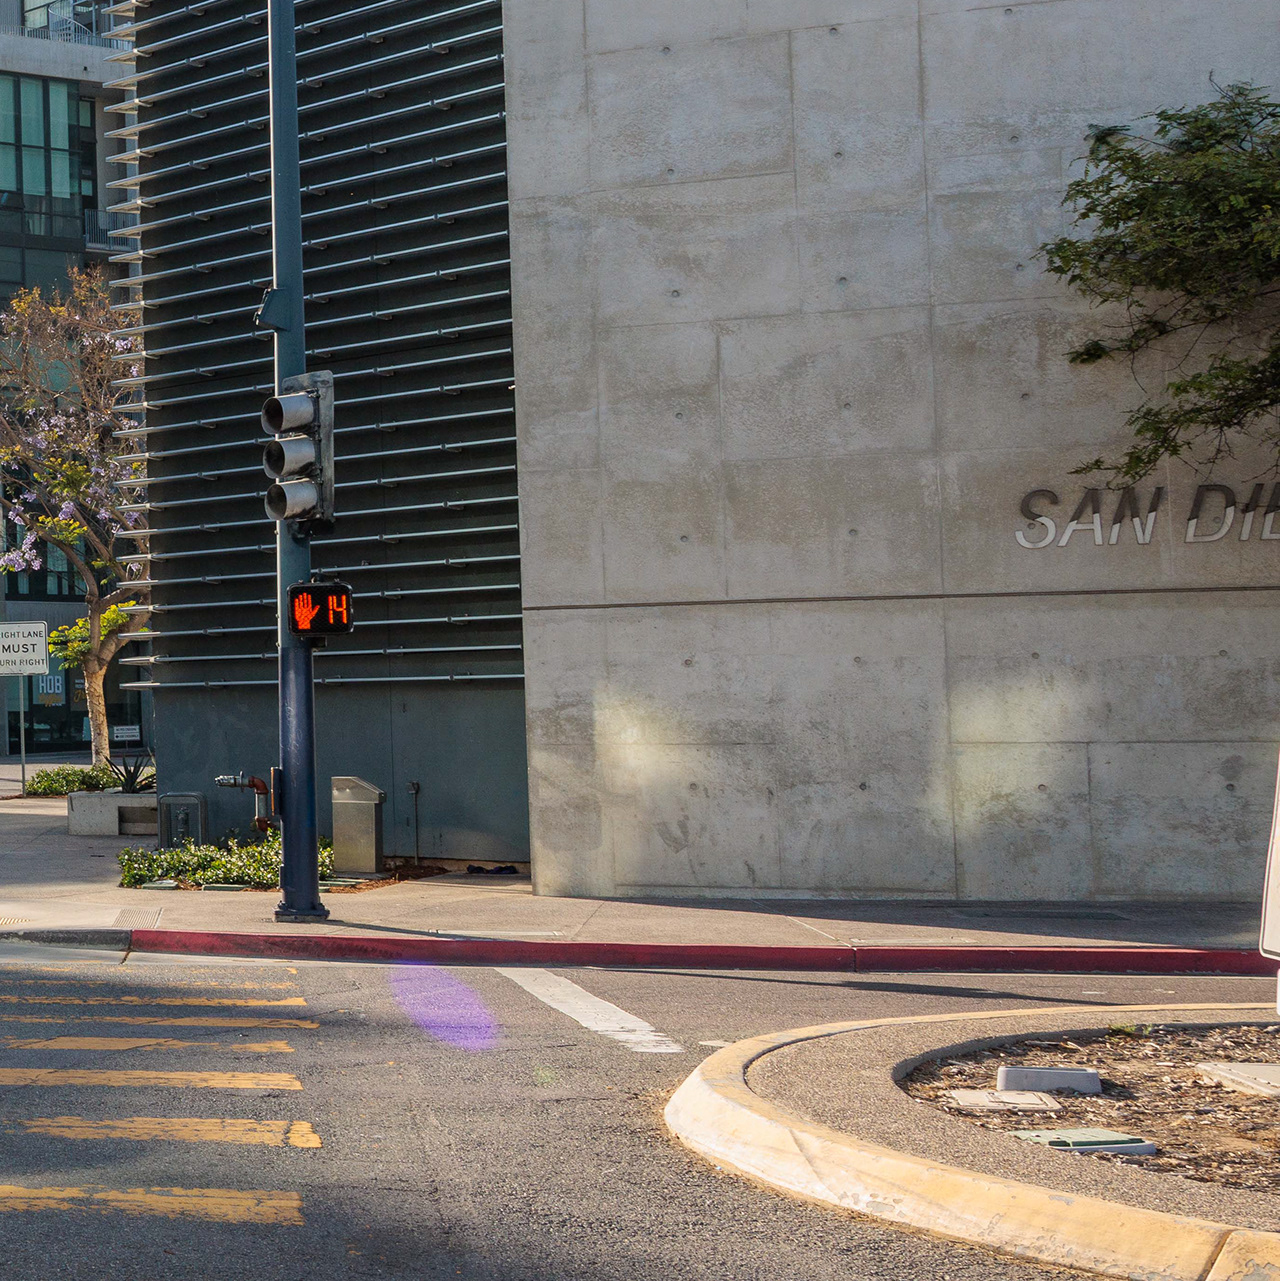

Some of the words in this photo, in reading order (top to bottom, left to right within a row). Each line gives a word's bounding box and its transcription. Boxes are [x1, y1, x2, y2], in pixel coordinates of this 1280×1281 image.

[1014, 486, 1165, 549] SAN
[328, 594, 348, 624] 14
[22, 630, 44, 638] LANE
[2, 643, 38, 654] MUST
[19, 658, 46, 666] RIGHT
[39, 675, 62, 694] HOB
